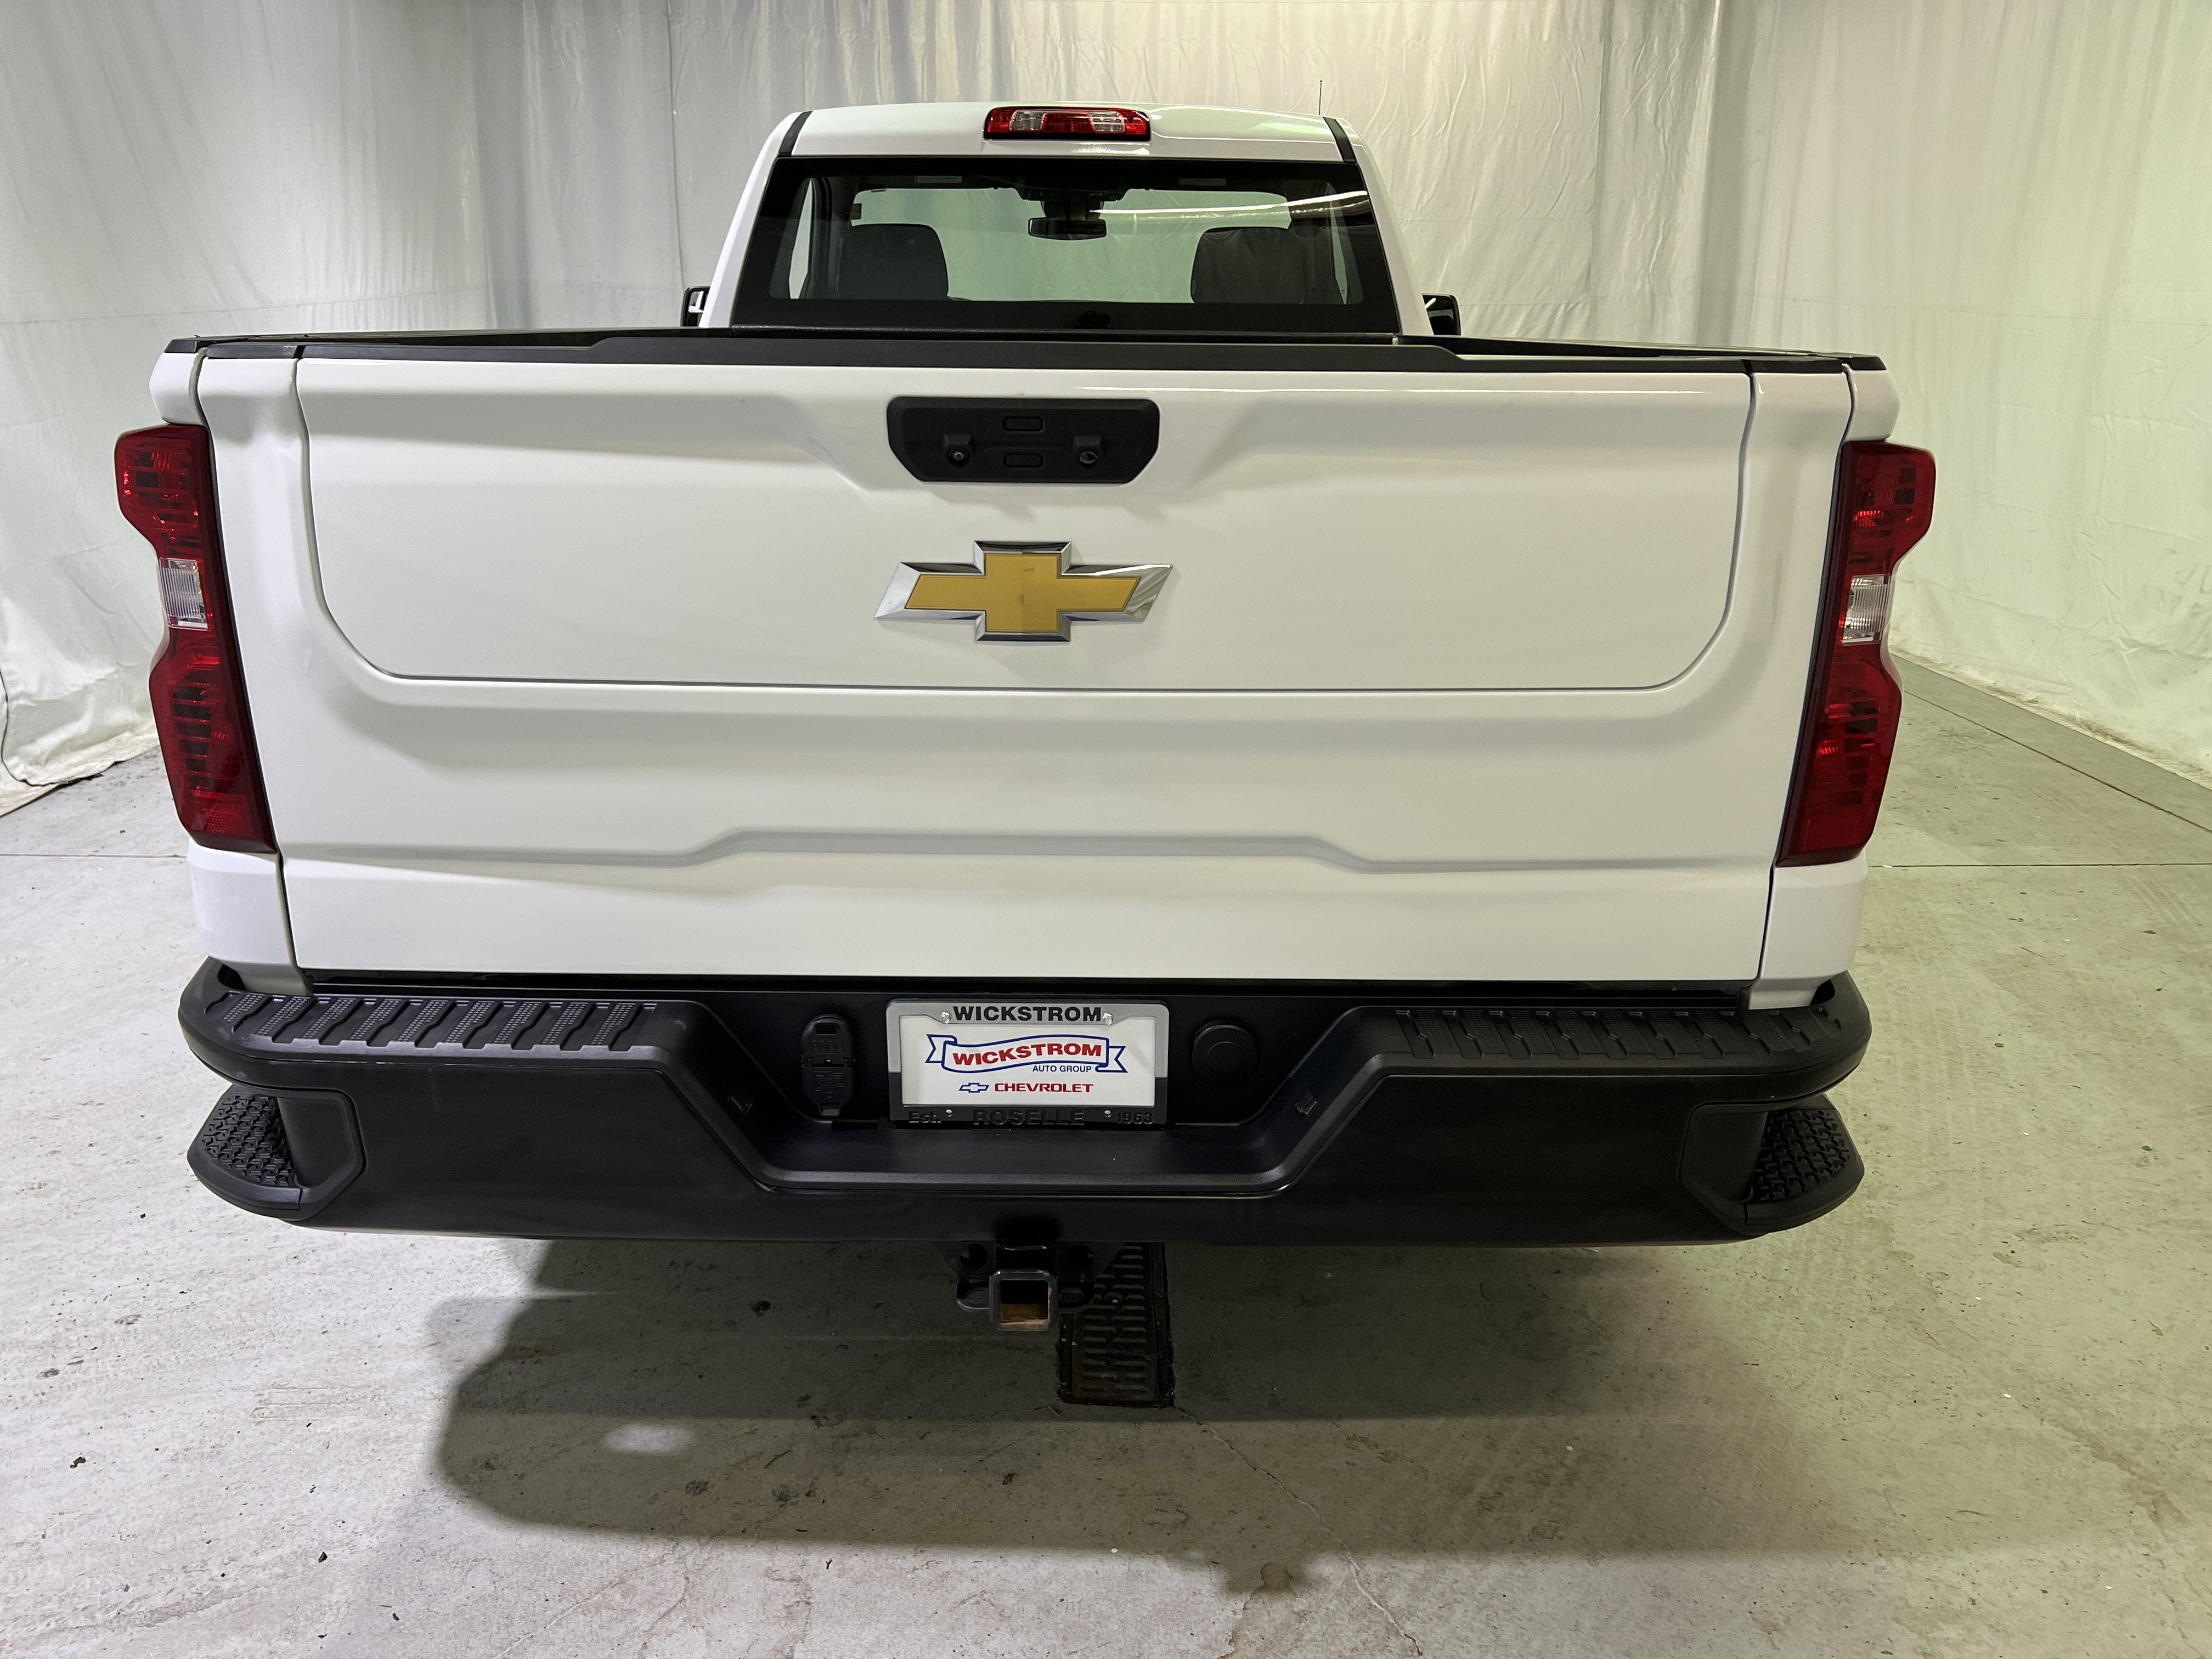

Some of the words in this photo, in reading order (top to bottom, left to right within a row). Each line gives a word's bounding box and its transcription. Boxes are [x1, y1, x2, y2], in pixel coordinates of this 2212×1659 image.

[952, 1006, 1101, 1022] WICKSTROM
[952, 1043, 1102, 1065] WICKSTROM
[994, 1083, 1093, 1092] CHEVROLET
[909, 1111, 941, 1123] Est.
[973, 1109, 1084, 1125] ROSELLE
[1115, 1111, 1153, 1125] 1963
